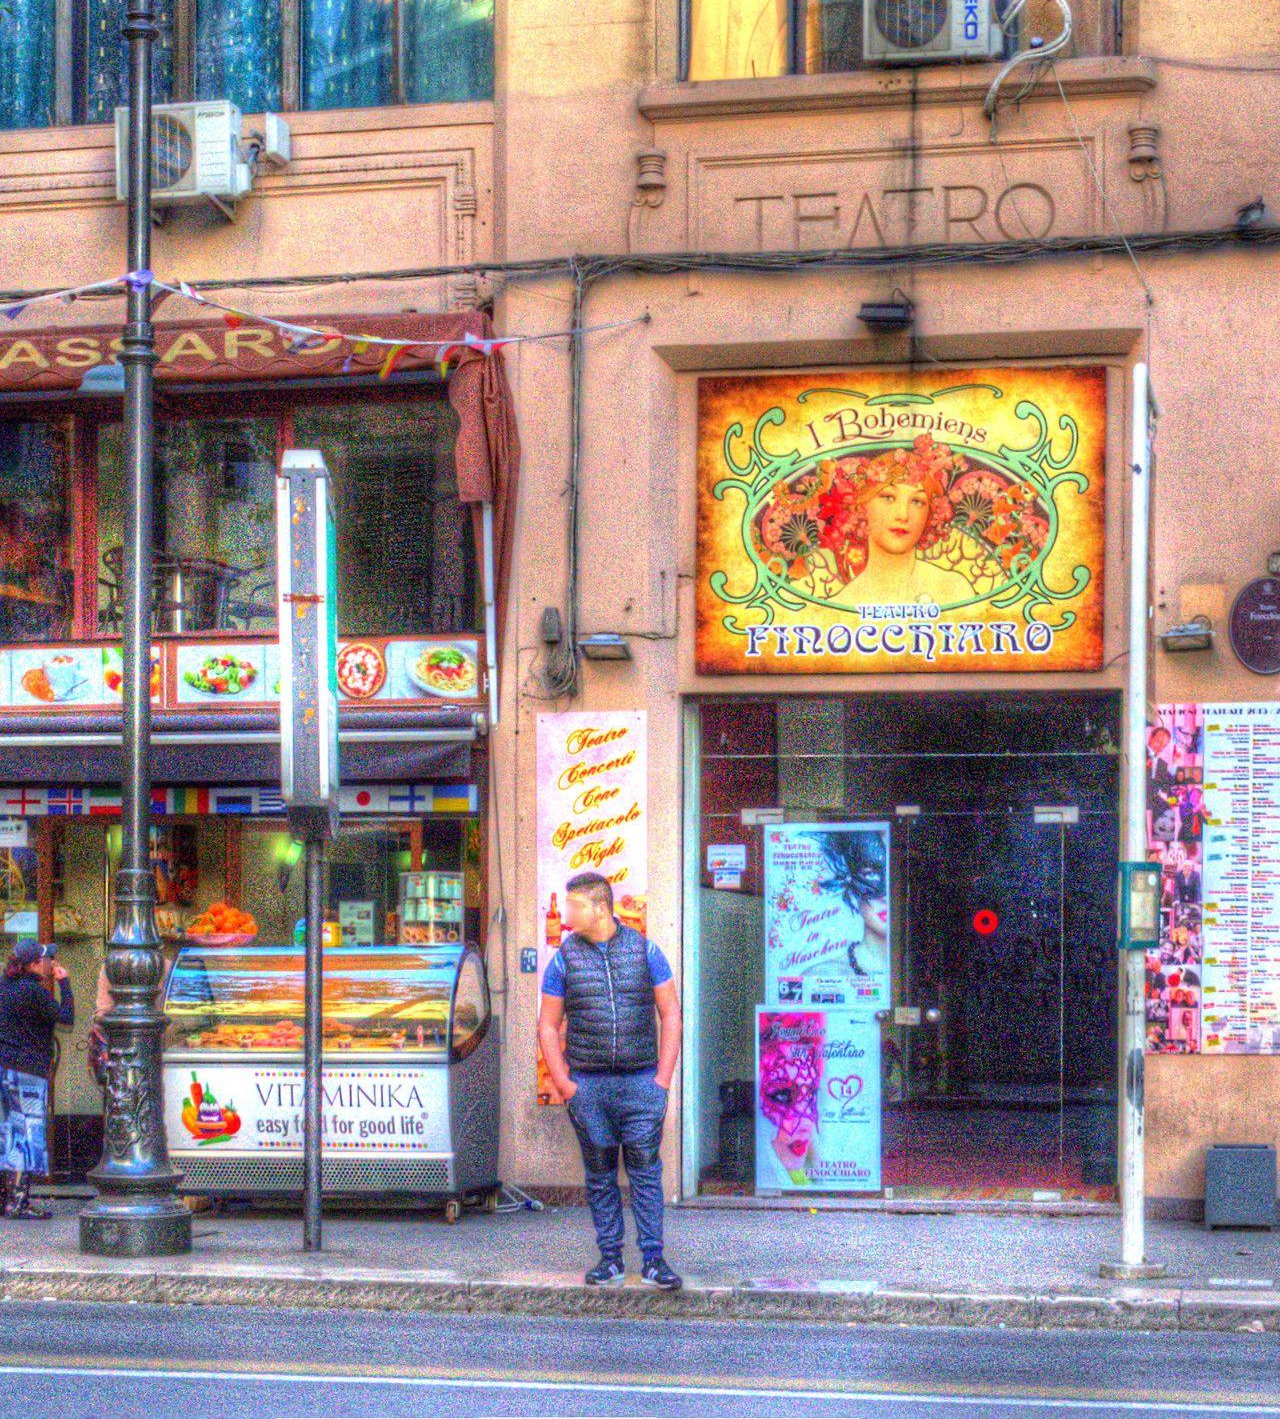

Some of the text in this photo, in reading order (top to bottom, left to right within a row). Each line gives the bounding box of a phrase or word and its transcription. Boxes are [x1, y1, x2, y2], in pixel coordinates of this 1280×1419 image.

[734, 182, 1056, 251] TEATRO
[805, 407, 988, 450] I Bohemiens
[858, 604, 940, 619] TEATRO
[746, 623, 1055, 661] FINOCCHIARO
[566, 727, 629, 755] Teatro
[558, 750, 636, 790] Concerti
[573, 785, 620, 814] Cene
[552, 802, 641, 850] Spettacolo
[570, 836, 625, 869] Night
[790, 906, 842, 932] Teatro
[807, 932, 820, 943] in
[779, 939, 849, 970] Maschera
[256, 1083, 425, 1108] VITMINIKA
[256, 1119, 289, 1137] easy
[332, 1115, 354, 1134] for
[359, 1116, 396, 1138] good
[805, 1169, 871, 1178] FINOCCHIARO
